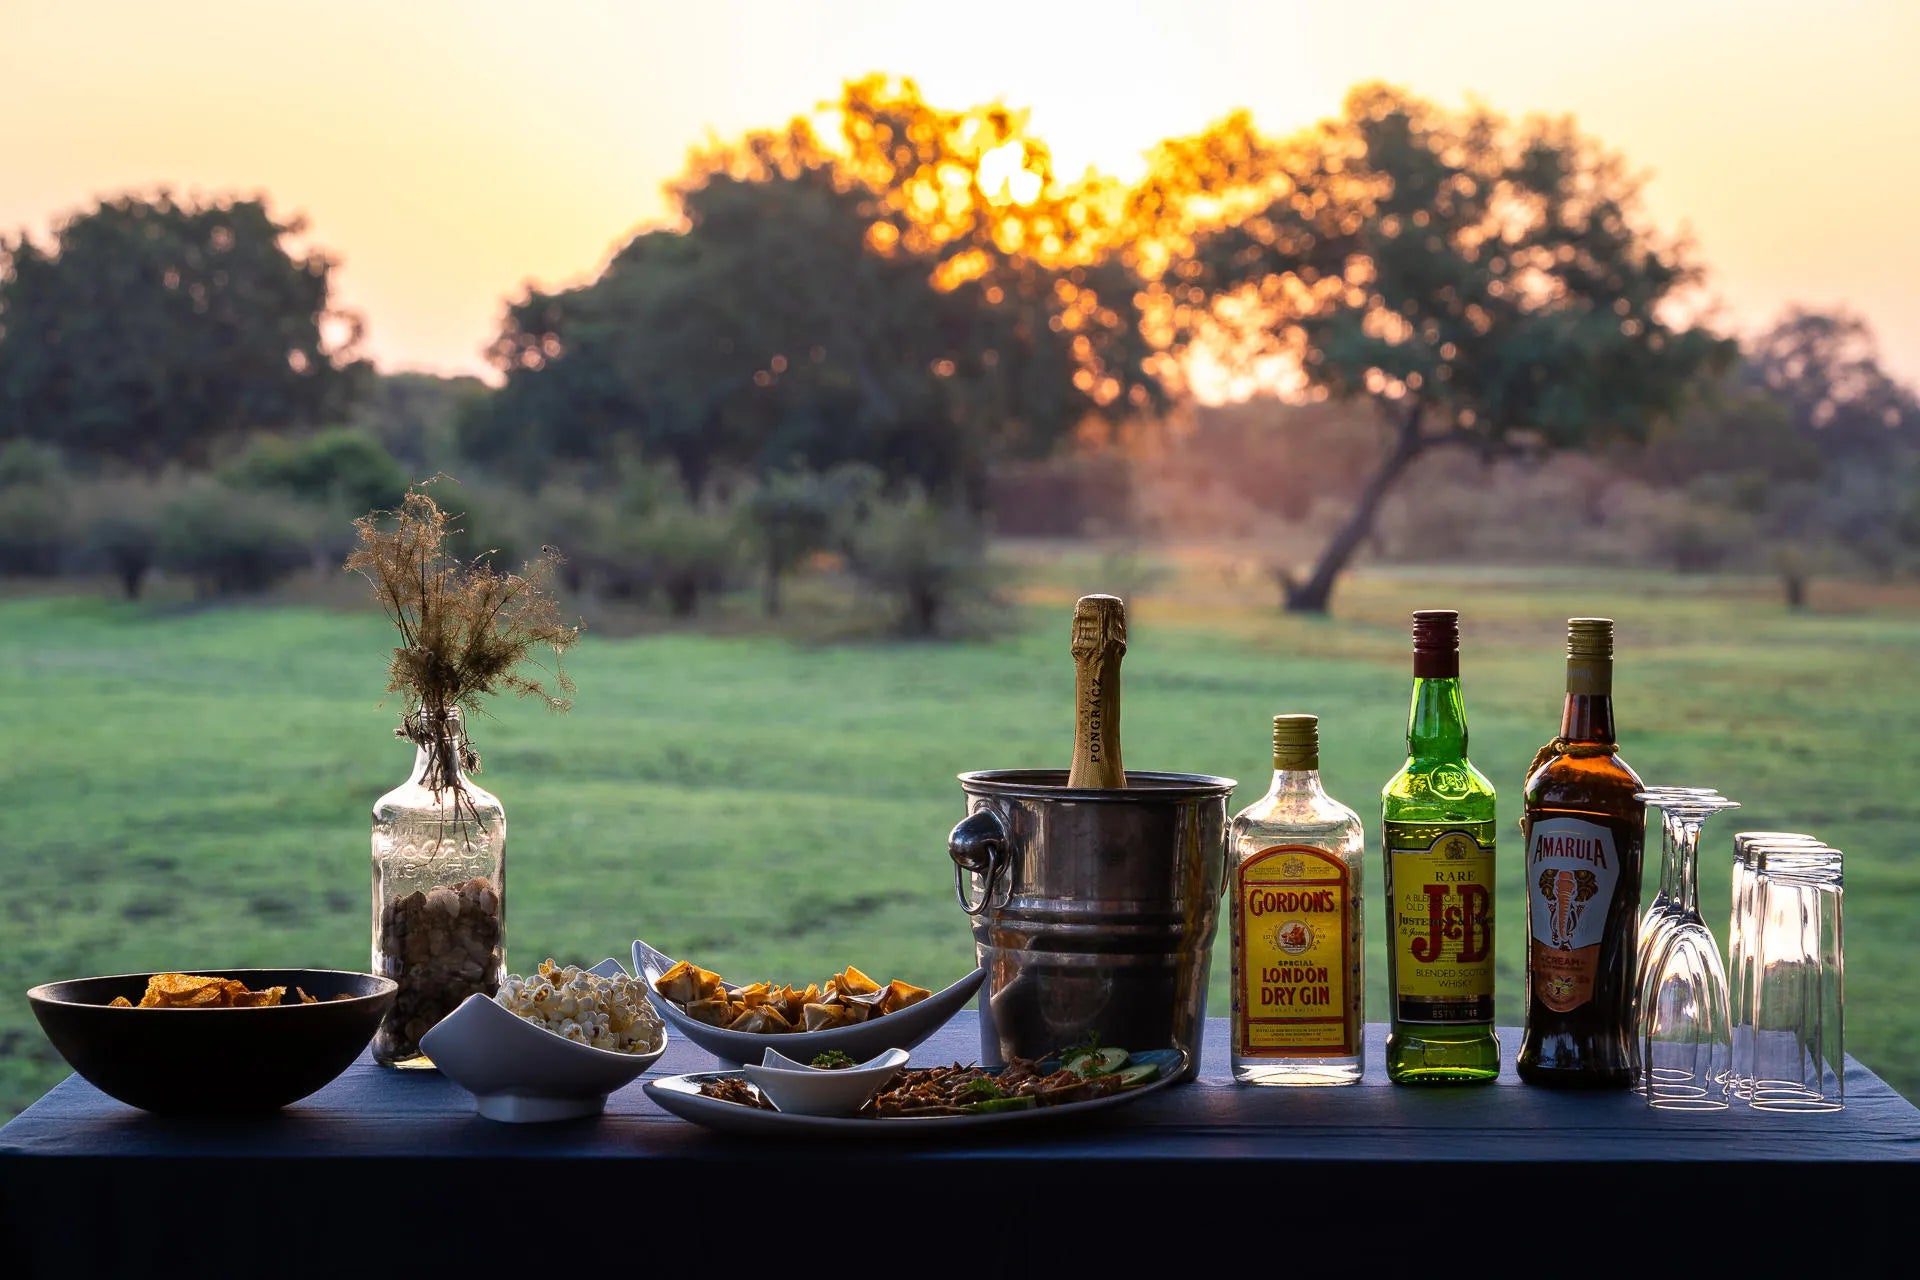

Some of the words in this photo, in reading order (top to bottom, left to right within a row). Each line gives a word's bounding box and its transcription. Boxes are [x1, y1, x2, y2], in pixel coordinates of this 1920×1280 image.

[1089, 678, 1102, 763] PONGRÁCZ
[1534, 834, 1607, 869] AMARULA
[1435, 871, 1475, 882] RARE
[1250, 889, 1335, 916] GORDON'S
[1411, 884, 1490, 963] J&B
[1262, 968, 1328, 983] LONDON
[1416, 968, 1456, 977] BLENDED
[1438, 980, 1473, 988] WHISKY
[1261, 987, 1296, 1005] DRY
[1299, 987, 1330, 1005] GIN
